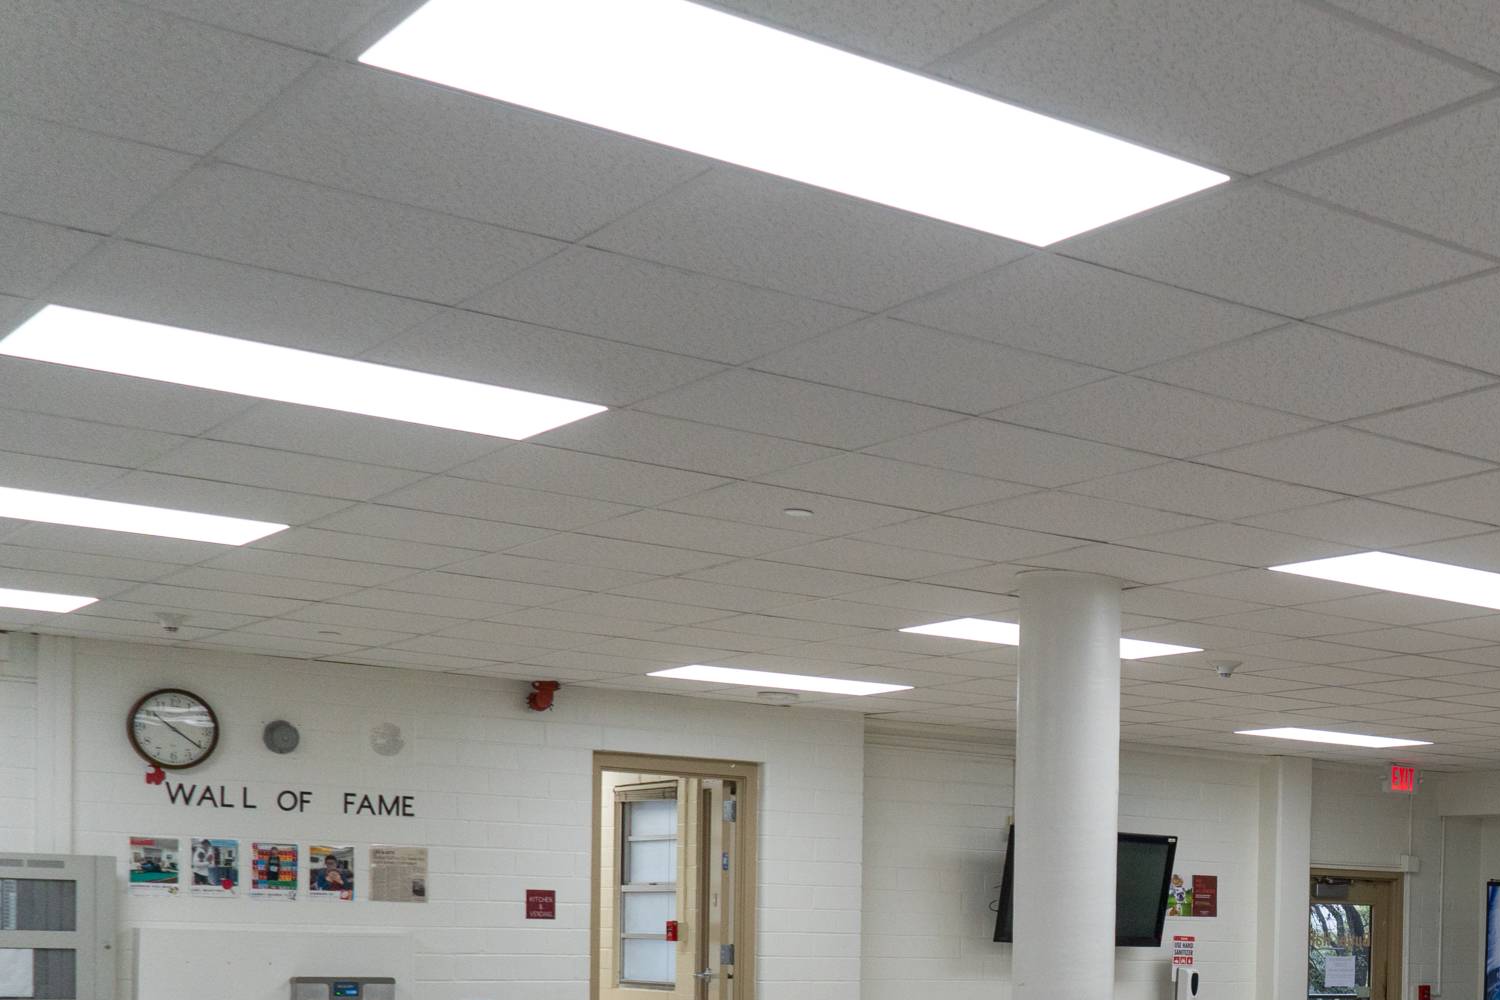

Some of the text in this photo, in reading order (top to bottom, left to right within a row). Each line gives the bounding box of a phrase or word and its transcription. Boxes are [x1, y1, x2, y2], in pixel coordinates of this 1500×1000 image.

[1391, 766, 1415, 792] EXIT
[165, 781, 415, 817] WALL OF FAME
